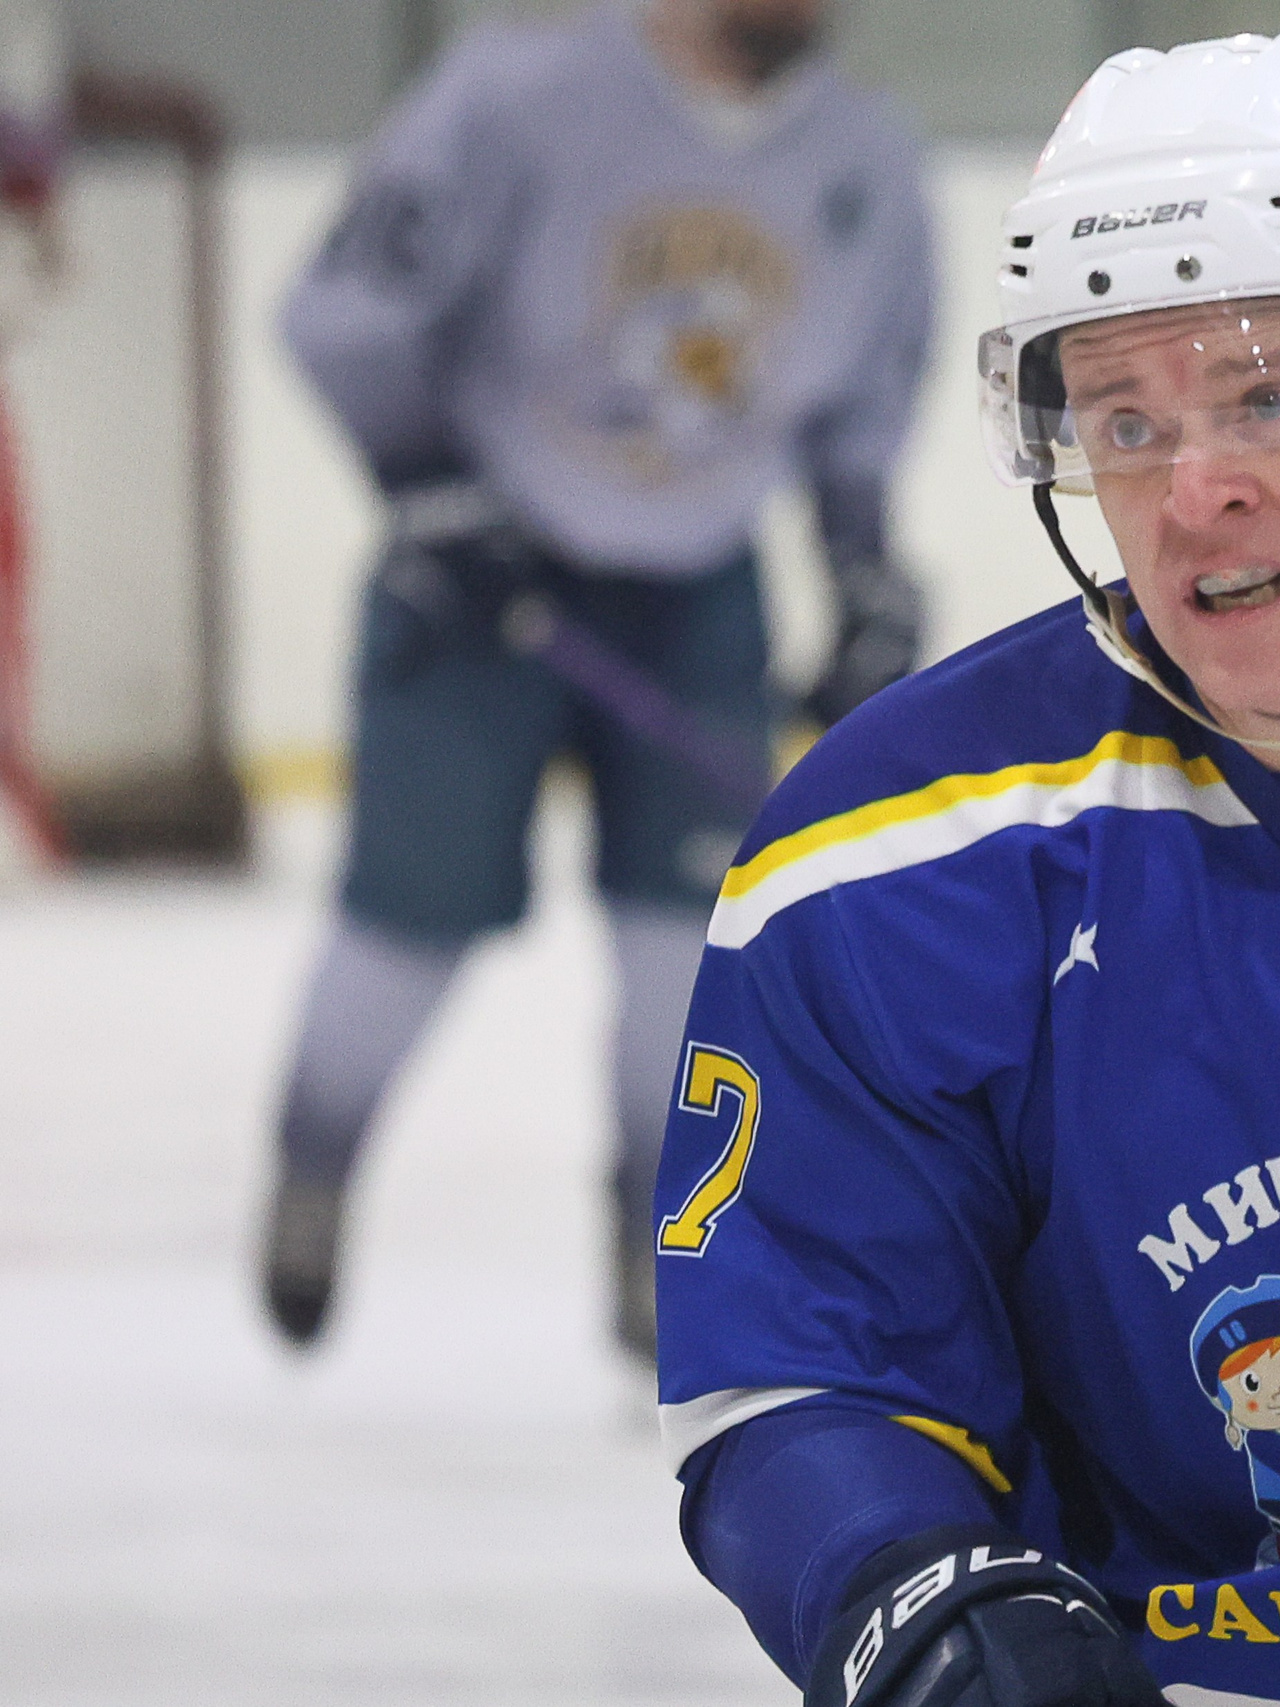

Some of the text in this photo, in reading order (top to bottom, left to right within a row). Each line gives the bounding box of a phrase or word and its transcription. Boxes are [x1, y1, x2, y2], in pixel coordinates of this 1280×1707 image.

[1070, 199, 1207, 239] BAUER
[657, 1040, 762, 1258] 7
[843, 1545, 1043, 1707] BAU
